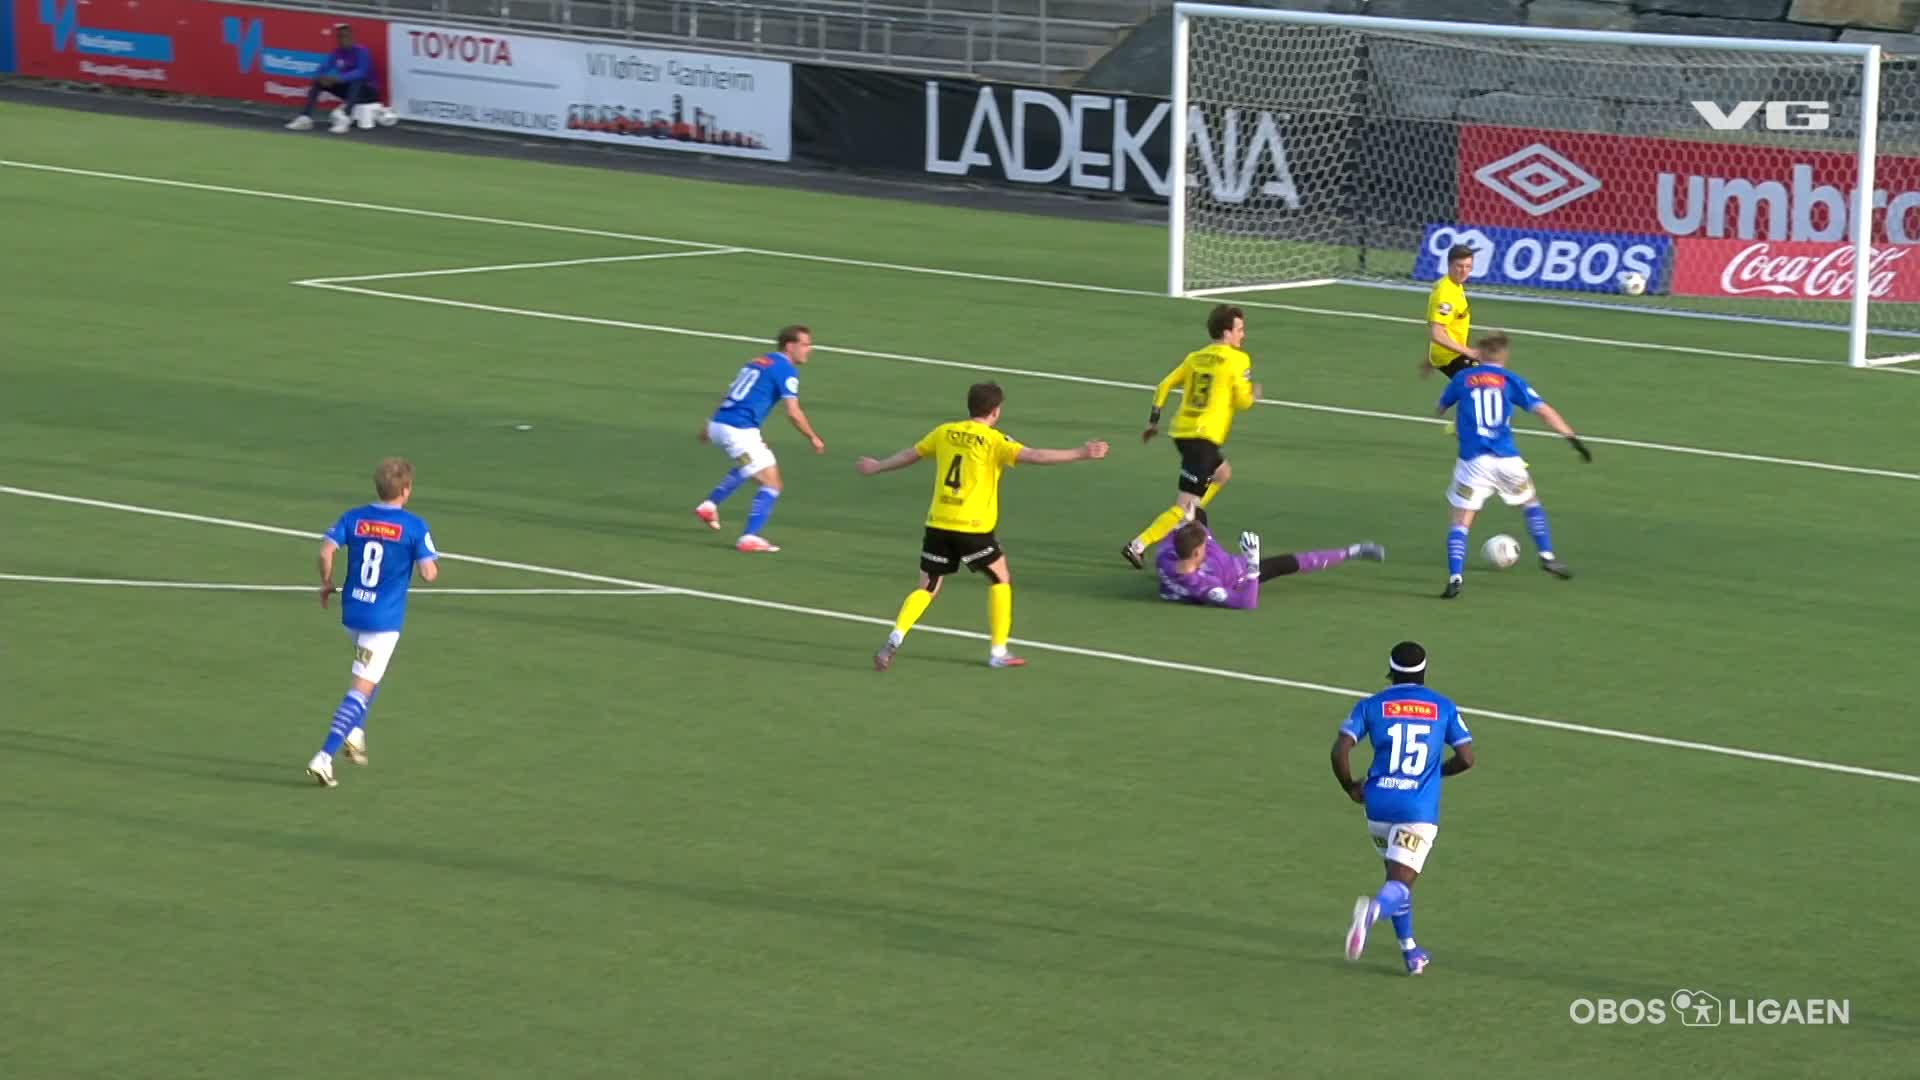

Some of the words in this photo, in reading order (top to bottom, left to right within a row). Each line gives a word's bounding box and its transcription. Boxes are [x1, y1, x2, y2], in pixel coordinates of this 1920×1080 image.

[408, 30, 513, 67] TOYOTA
[408, 98, 481, 122] MATERIAL
[482, 106, 560, 131] HANDLING
[1503, 237, 1657, 285] OBOS
[1470, 387, 1504, 428] 10
[946, 429, 986, 447] TOTEN
[943, 453, 964, 490] 4
[360, 541, 384, 588] 8
[1402, 705, 1432, 714] EXTRA
[1387, 723, 1431, 776] 15
